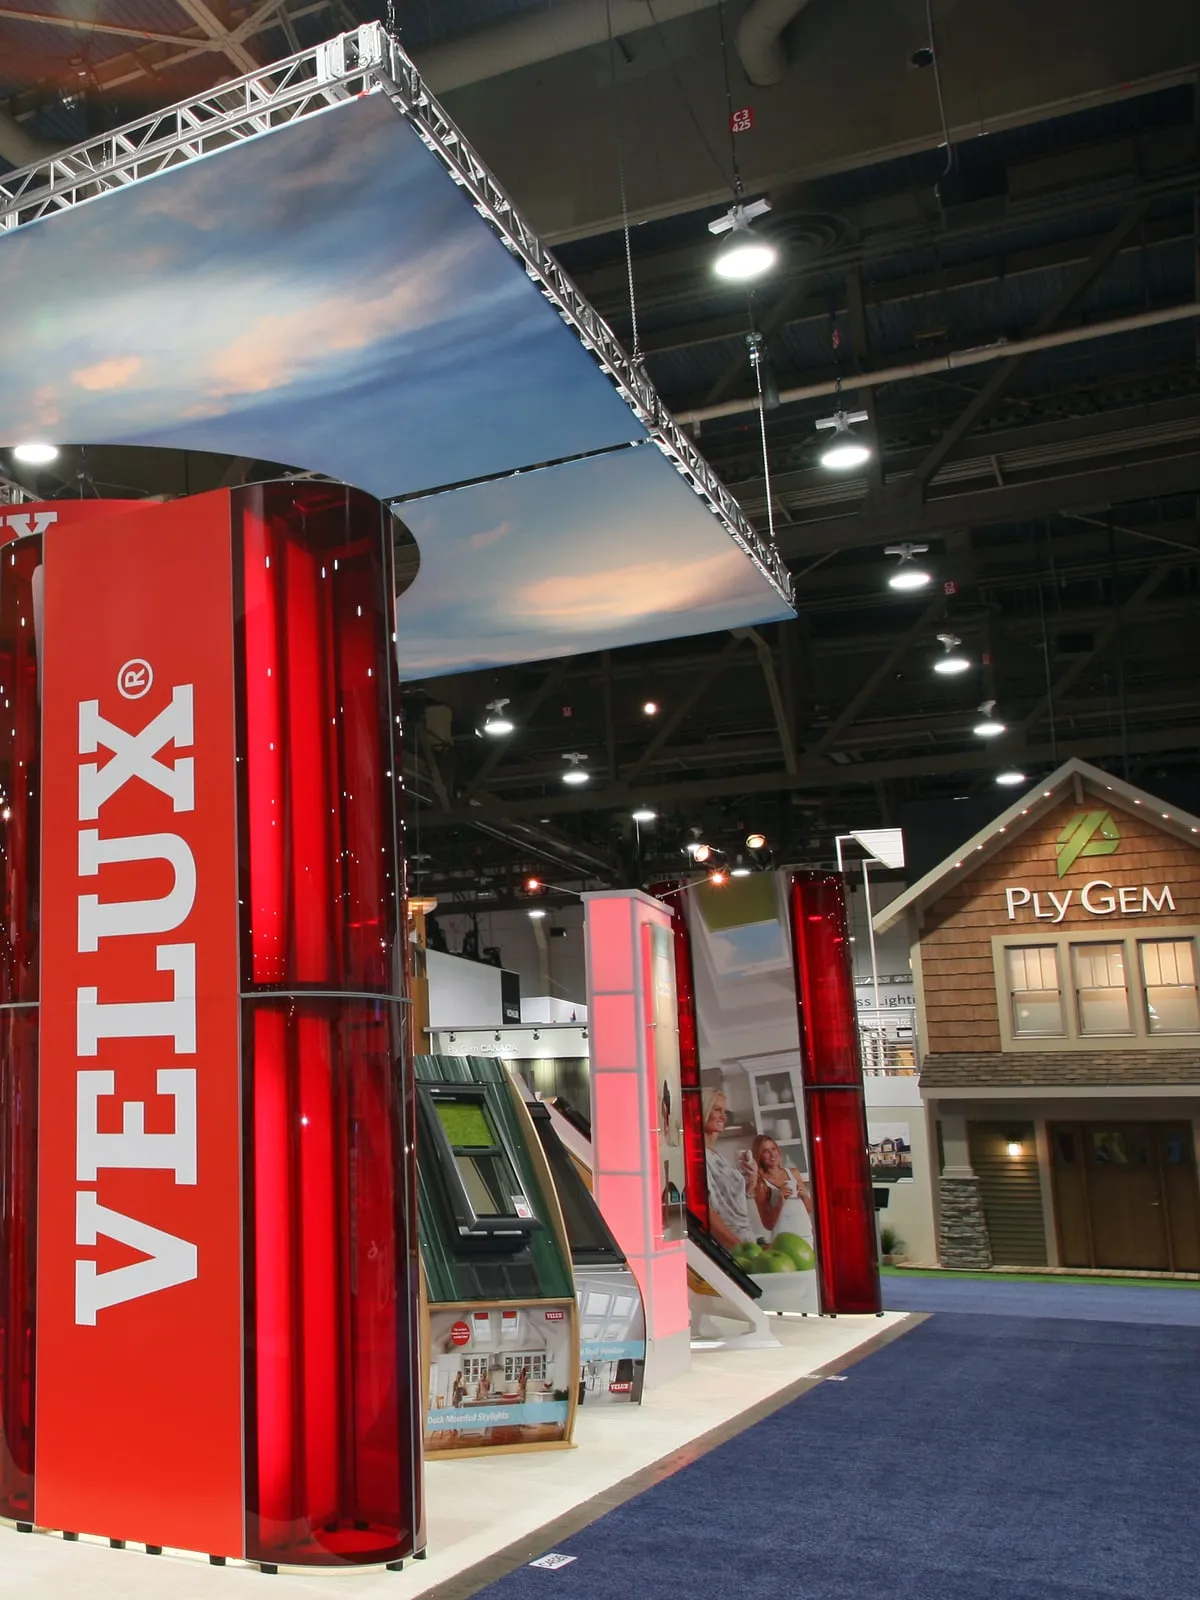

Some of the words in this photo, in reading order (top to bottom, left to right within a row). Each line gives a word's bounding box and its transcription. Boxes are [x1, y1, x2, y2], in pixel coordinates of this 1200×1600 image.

[732, 119, 751, 132] 425
[1081, 880, 1176, 914] GEM
[75, 684, 198, 1326] VELUX
[446, 1413, 476, 1423] Mounted
[478, 1411, 509, 1422] Skylights
